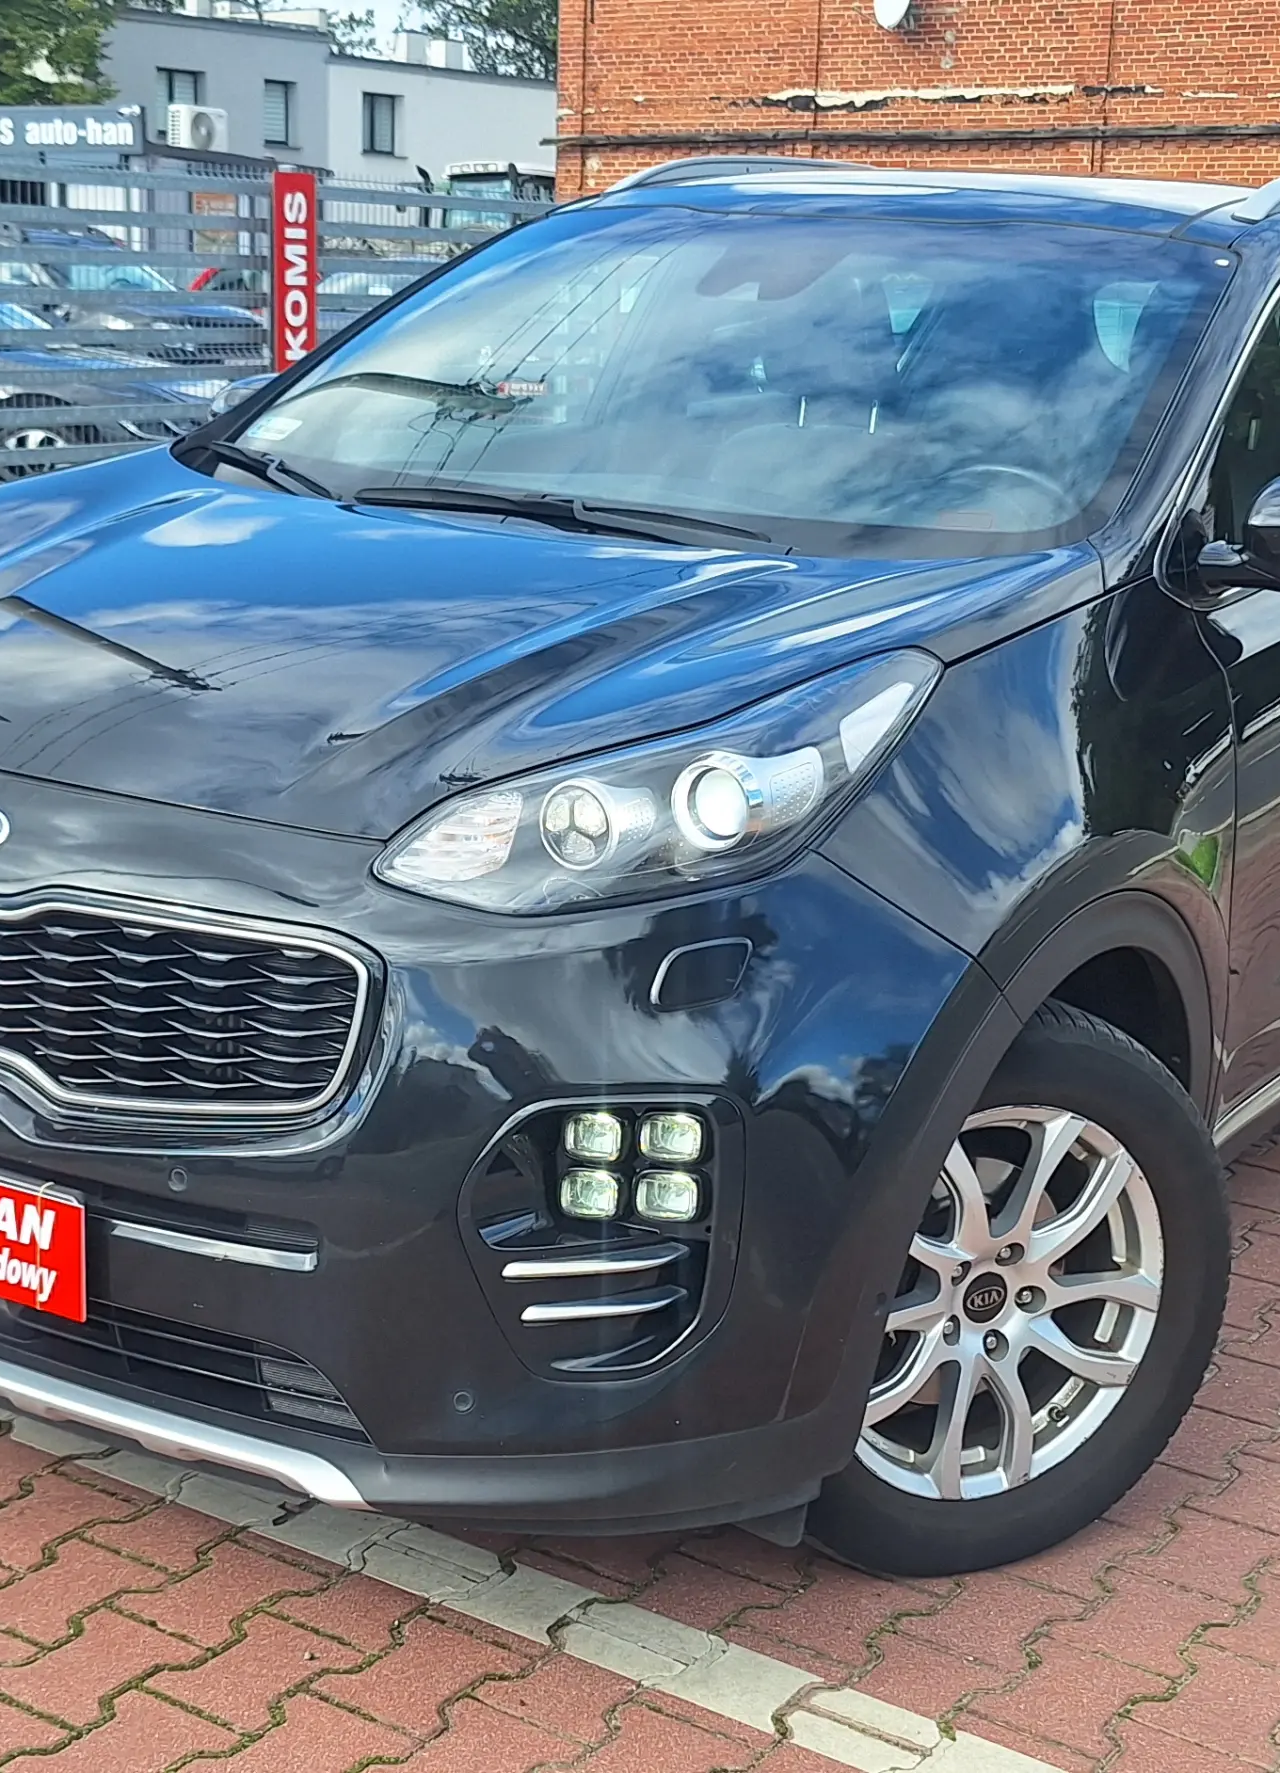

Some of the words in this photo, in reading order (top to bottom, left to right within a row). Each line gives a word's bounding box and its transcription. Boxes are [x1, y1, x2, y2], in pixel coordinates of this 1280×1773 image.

[24, 116, 135, 147] auto-han
[283, 190, 308, 362] KOMIS
[972, 1289, 1001, 1309] KIA
